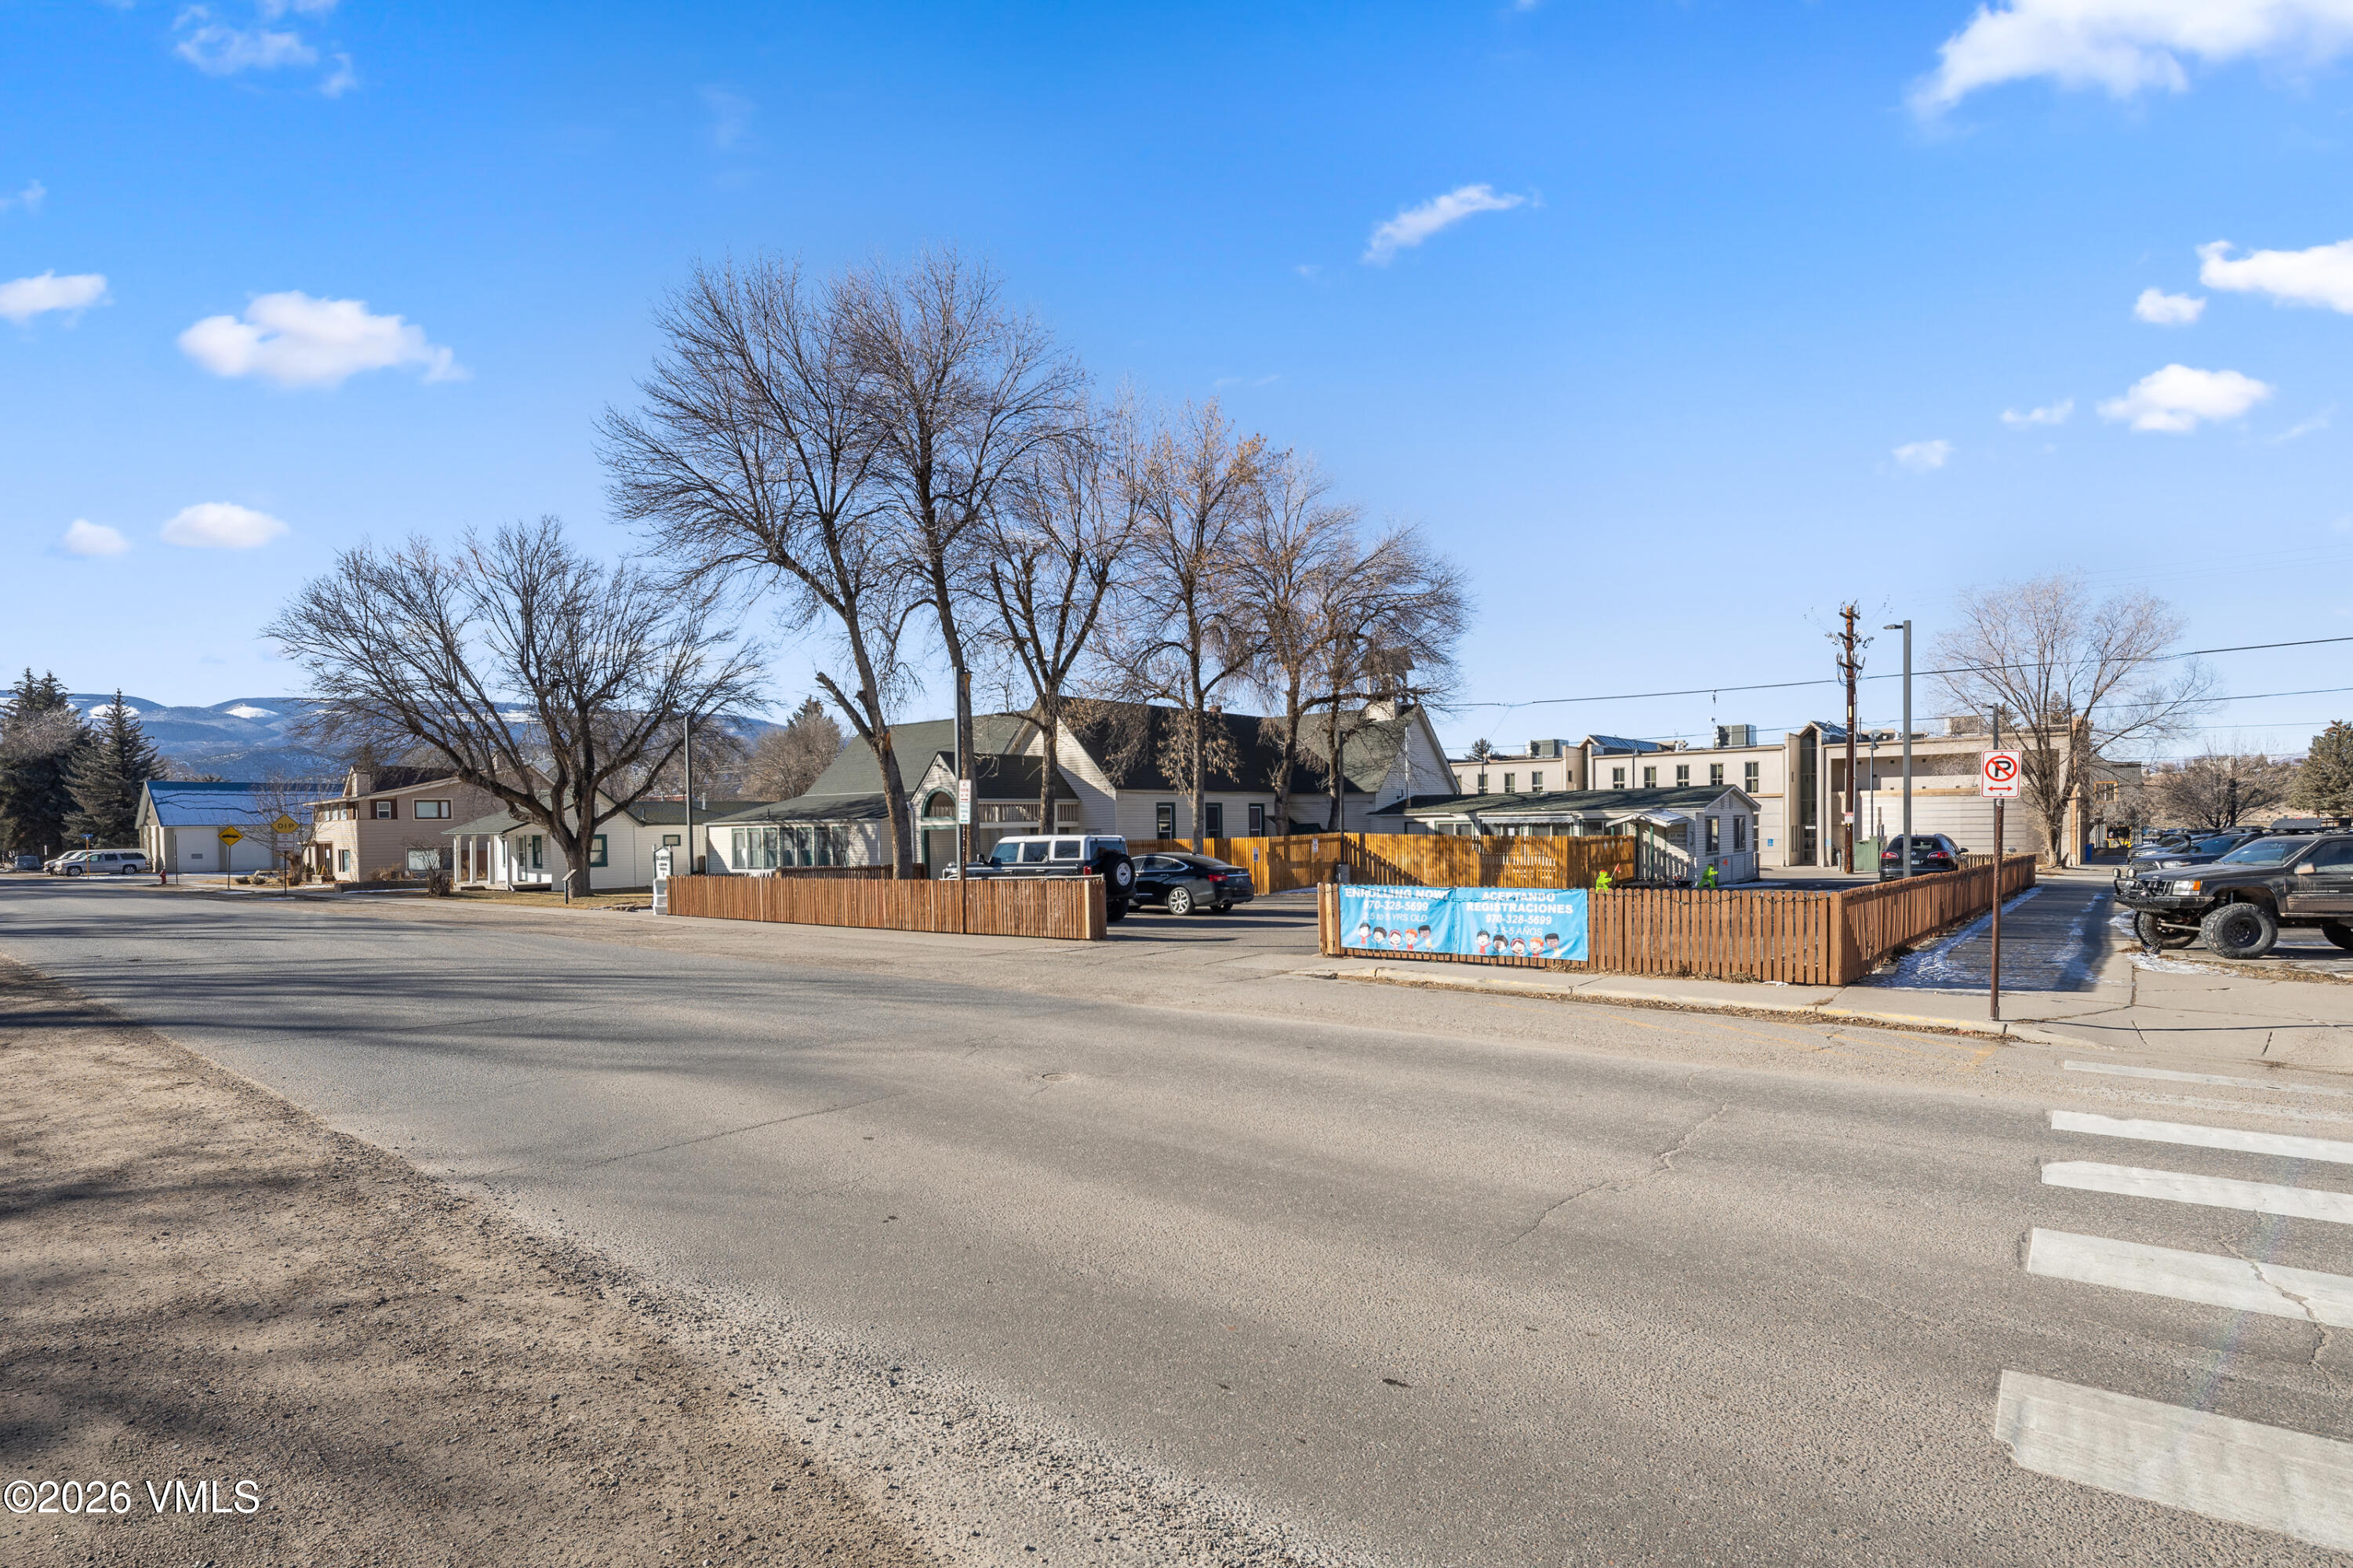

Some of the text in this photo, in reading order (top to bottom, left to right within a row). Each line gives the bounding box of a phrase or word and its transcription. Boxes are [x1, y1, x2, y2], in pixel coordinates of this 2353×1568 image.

[1345, 888, 1412, 898] ENROLLING
[1482, 891, 1555, 902] ACEPTANDO
[1364, 900, 1428, 911] 970-328-5699
[1466, 902, 1573, 914] REGISTRACIONES
[1486, 915, 1552, 925] 970-328-5699
[1515, 926, 1543, 936] AÑOS
